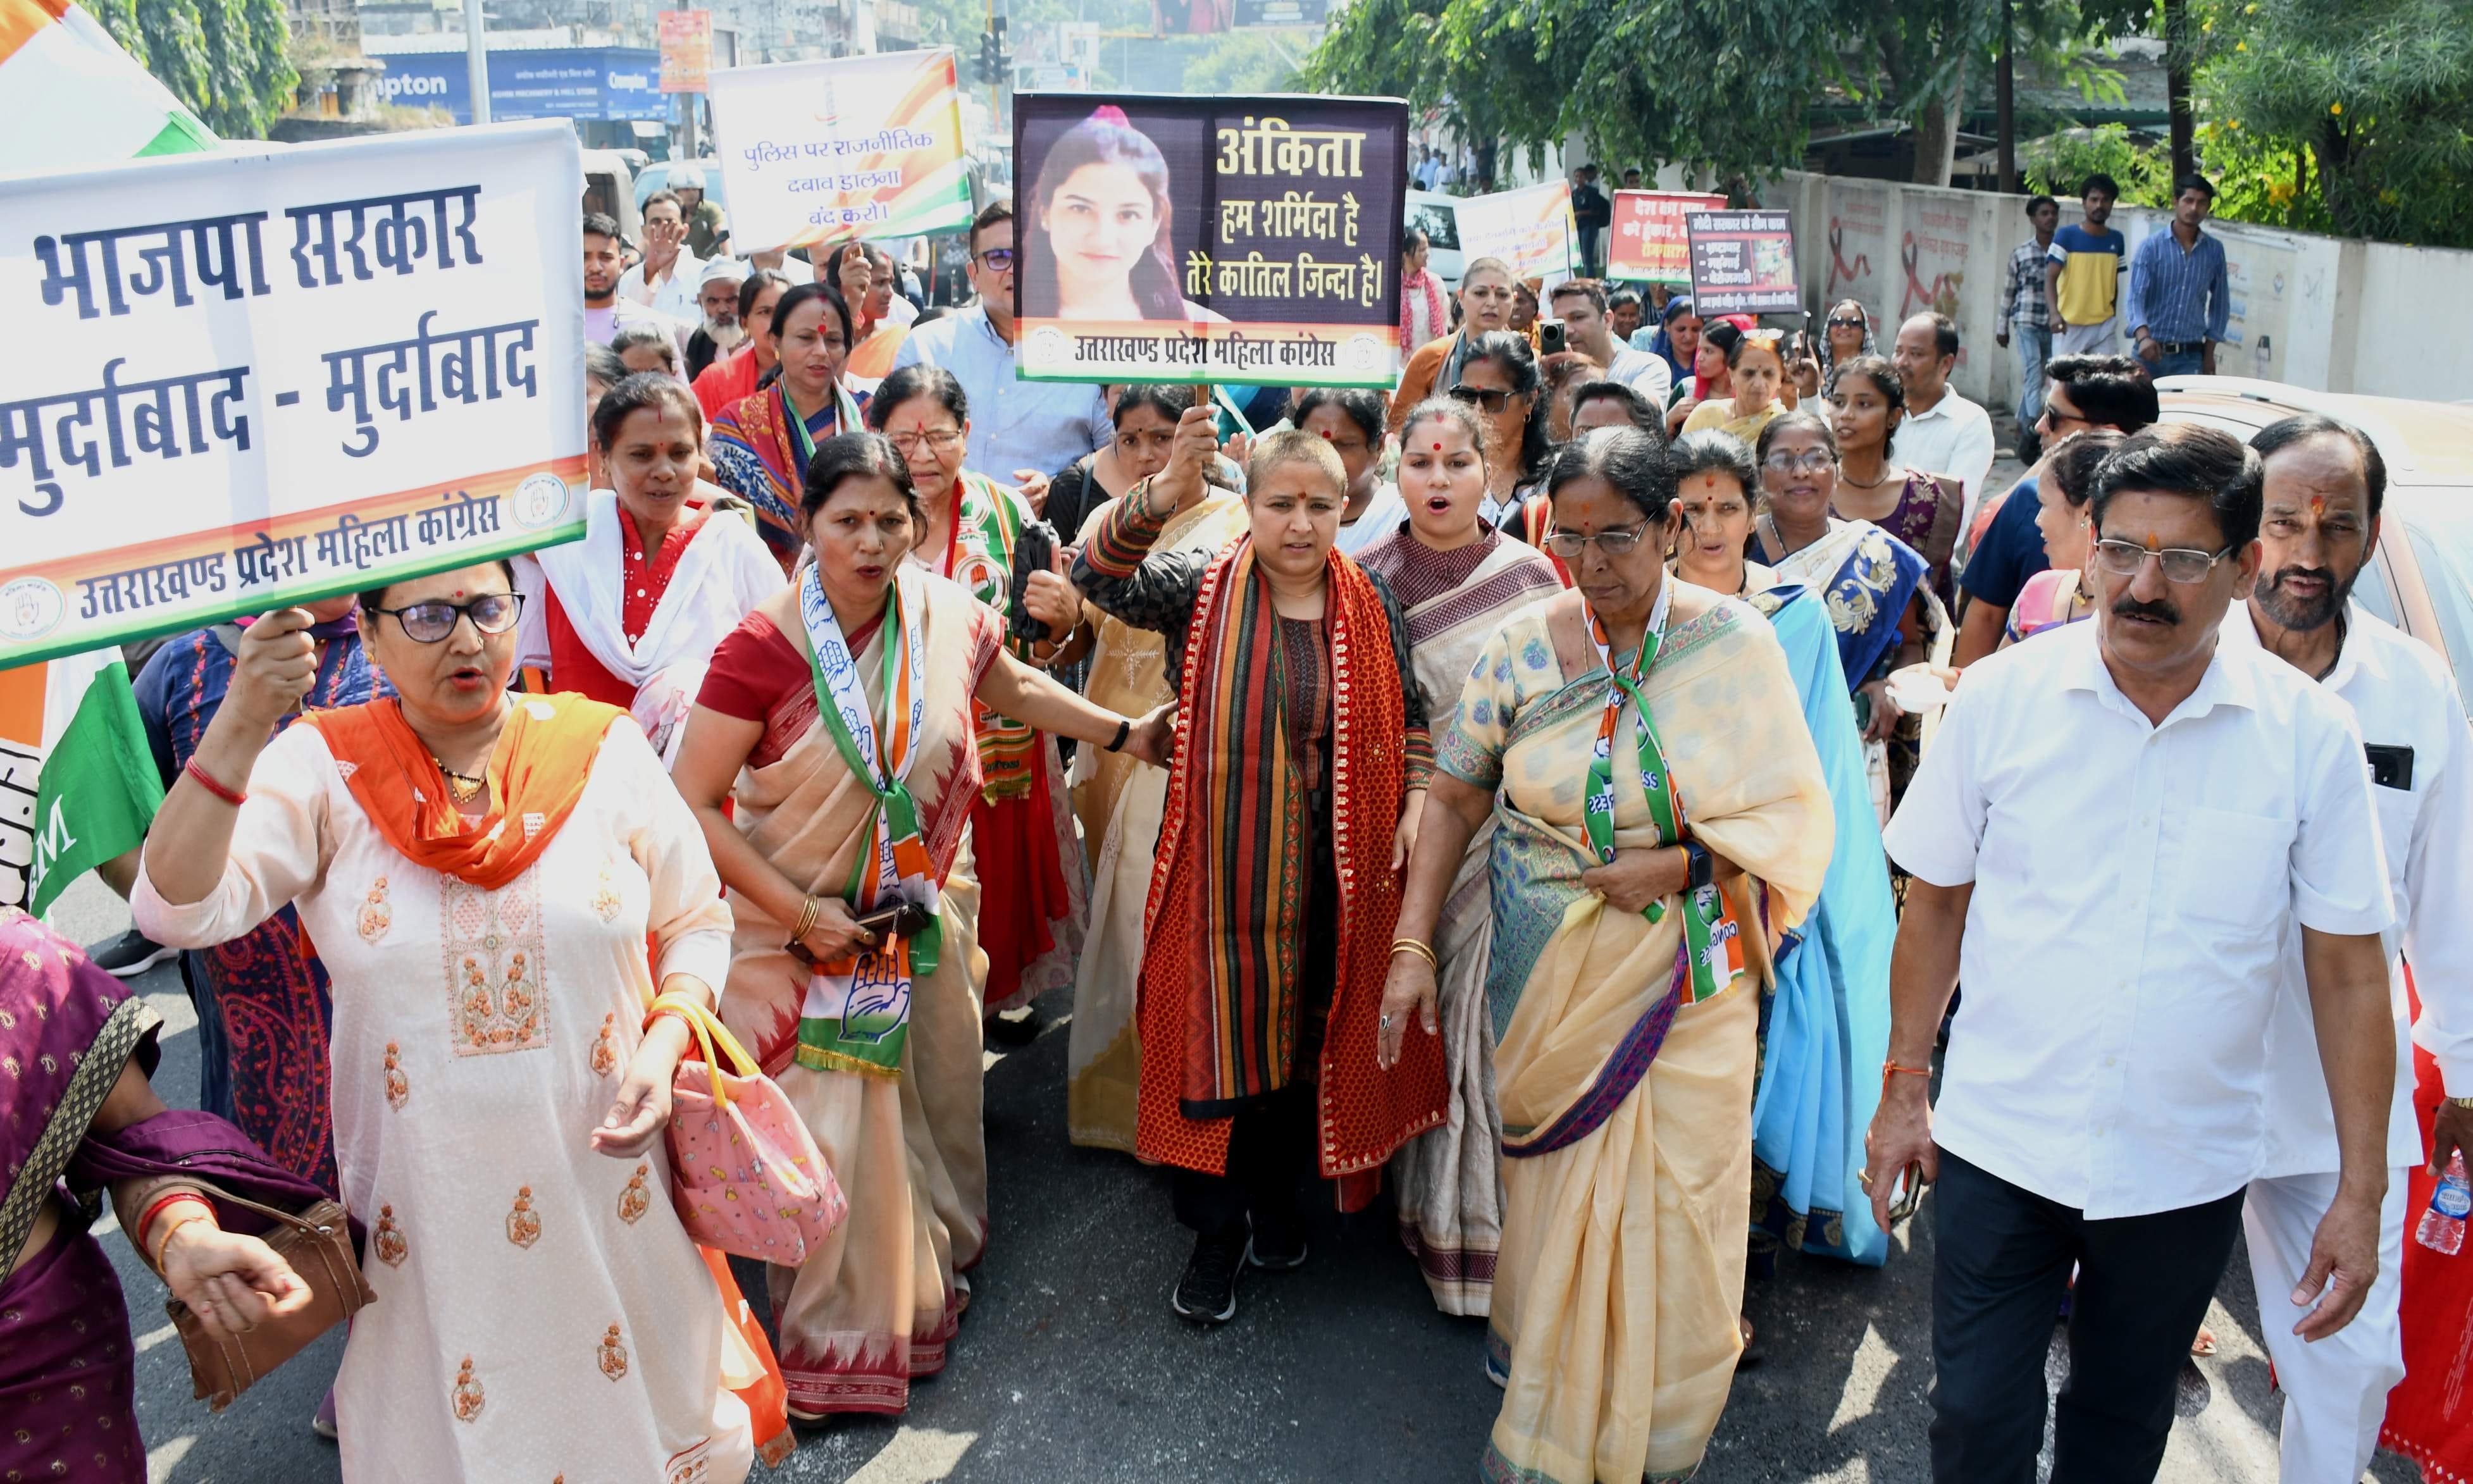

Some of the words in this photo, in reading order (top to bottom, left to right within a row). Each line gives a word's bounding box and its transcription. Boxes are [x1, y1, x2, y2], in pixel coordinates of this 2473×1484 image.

[743, 141, 798, 171] पुलिस
[804, 142, 829, 158] पर
[833, 129, 933, 156] राजनीतिक
[1217, 116, 1367, 177] अंकिता
[839, 170, 900, 190] डालना
[809, 205, 835, 225] बंद
[1221, 200, 1256, 244] हम
[1342, 192, 1360, 247] है
[34, 211, 271, 319] भाजपा
[284, 185, 483, 288] सरकार
[1186, 250, 1213, 295] तेरे
[1218, 251, 1292, 298] कातिल
[1298, 252, 1357, 301] जिन्दा
[1074, 336, 1159, 362] उत्तराखण्ड
[1165, 331, 1209, 365] प्रदेश
[1215, 332, 1274, 371] महिला
[1280, 333, 1336, 366] कांग्रेस
[0, 357, 251, 517] मुर्दाबाद
[321, 311, 540, 457] मुर्दाबाद
[76, 552, 227, 620] उत्तराखण्ड
[235, 533, 308, 588] प्रदेश
[318, 513, 410, 570] महिला
[417, 492, 501, 544] कांग्रेस
